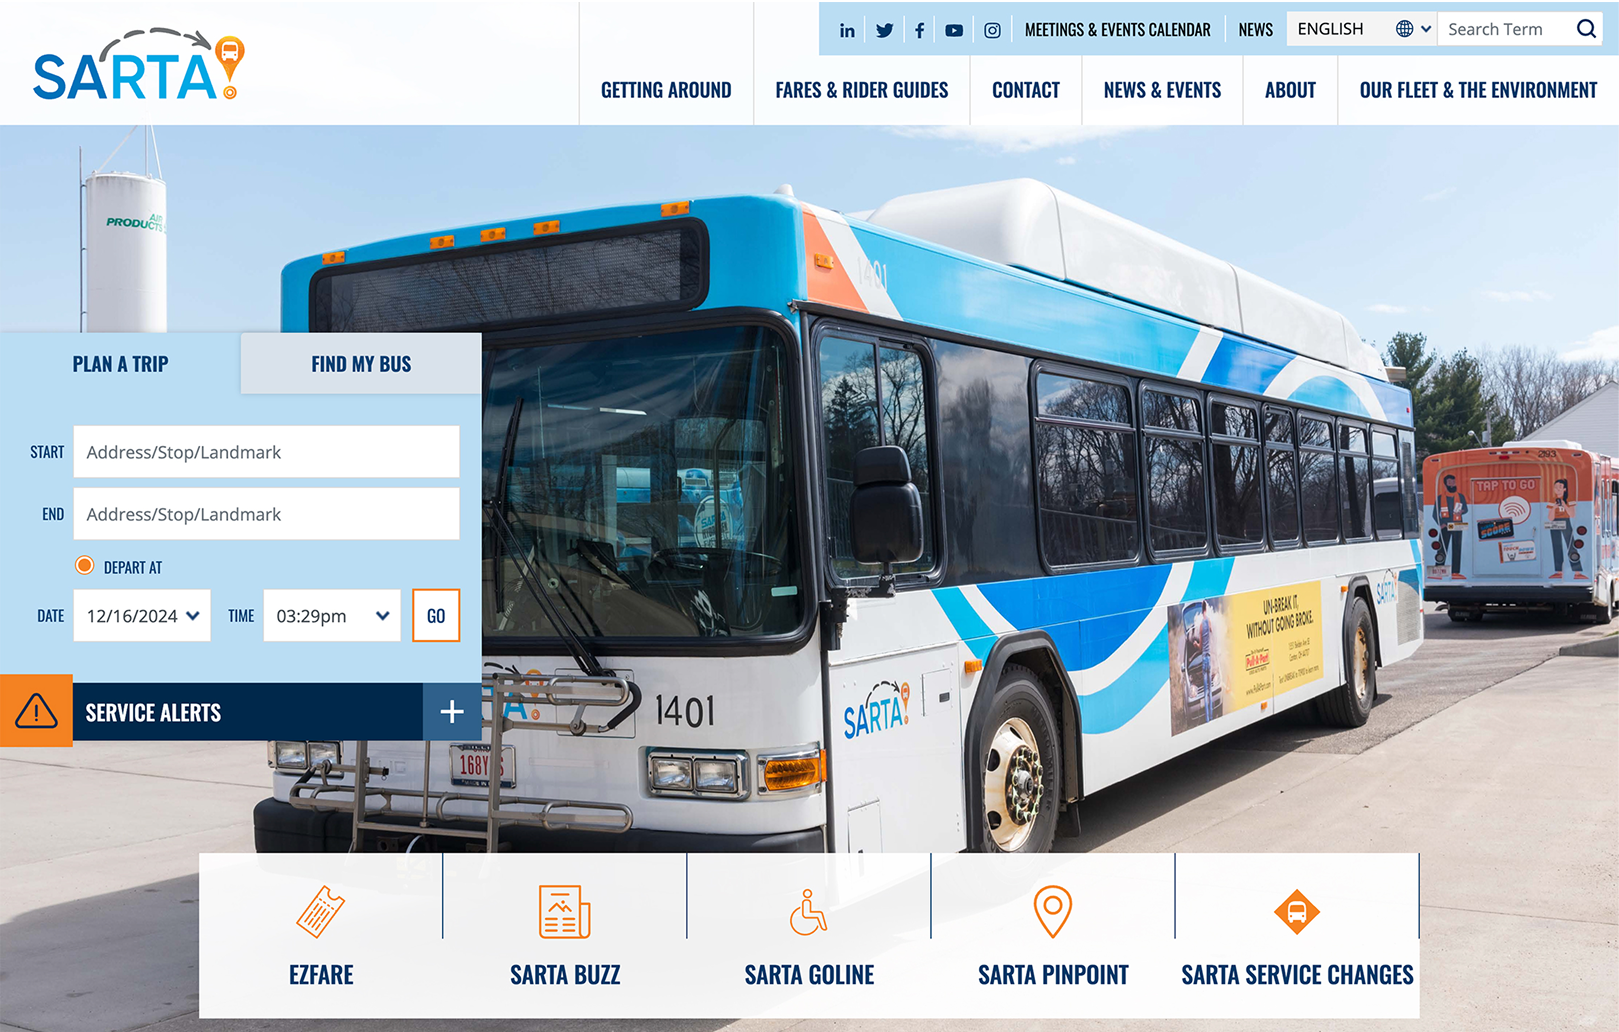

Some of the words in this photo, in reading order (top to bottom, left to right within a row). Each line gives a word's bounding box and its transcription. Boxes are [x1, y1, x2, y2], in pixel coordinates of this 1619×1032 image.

[106, 217, 163, 232] PRODUCTS
[149, 214, 163, 223] AIR
[857, 257, 888, 292] 1401
[1476, 480, 1499, 491] TAP
[1501, 480, 1517, 490] TO
[1520, 479, 1535, 490] GO
[1481, 522, 1510, 538] SCORE
[1263, 596, 1292, 615] UN-BREAK
[1246, 619, 1275, 639] WITHOUT
[1275, 614, 1295, 632] GOING
[1295, 610, 1314, 627] BROKE.
[656, 694, 714, 728] 1401
[460, 755, 504, 776] 168YS
